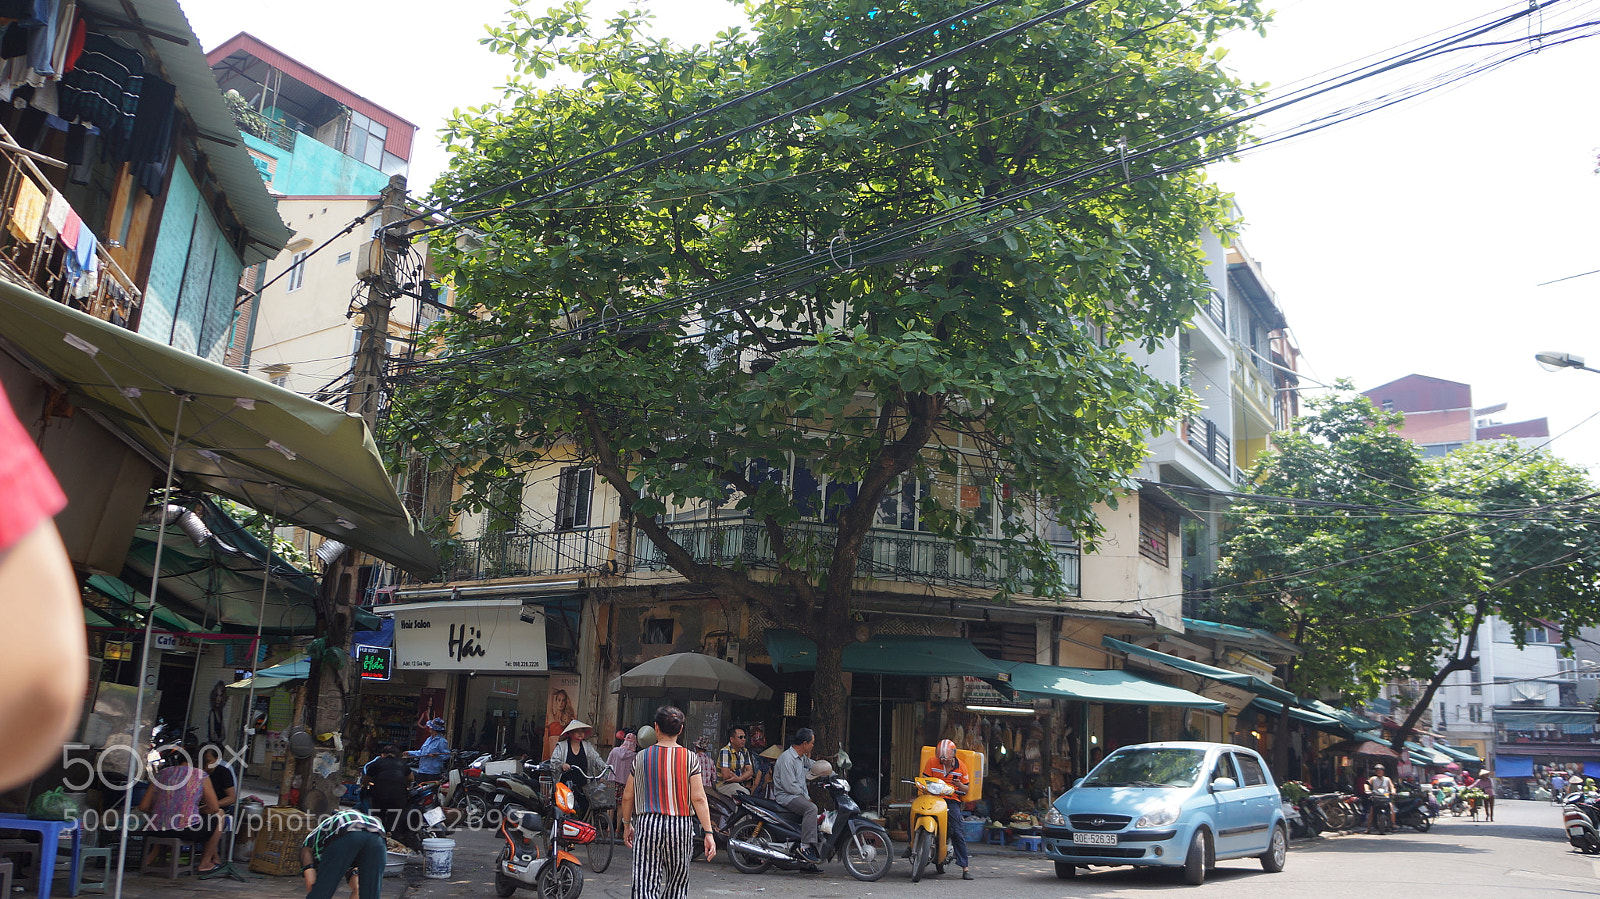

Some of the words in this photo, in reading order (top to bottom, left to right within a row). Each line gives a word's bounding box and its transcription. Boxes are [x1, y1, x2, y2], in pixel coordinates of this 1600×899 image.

[401, 620, 413, 629] Hair
[414, 619, 431, 629] Salon
[157, 635, 177, 646] Cafe
